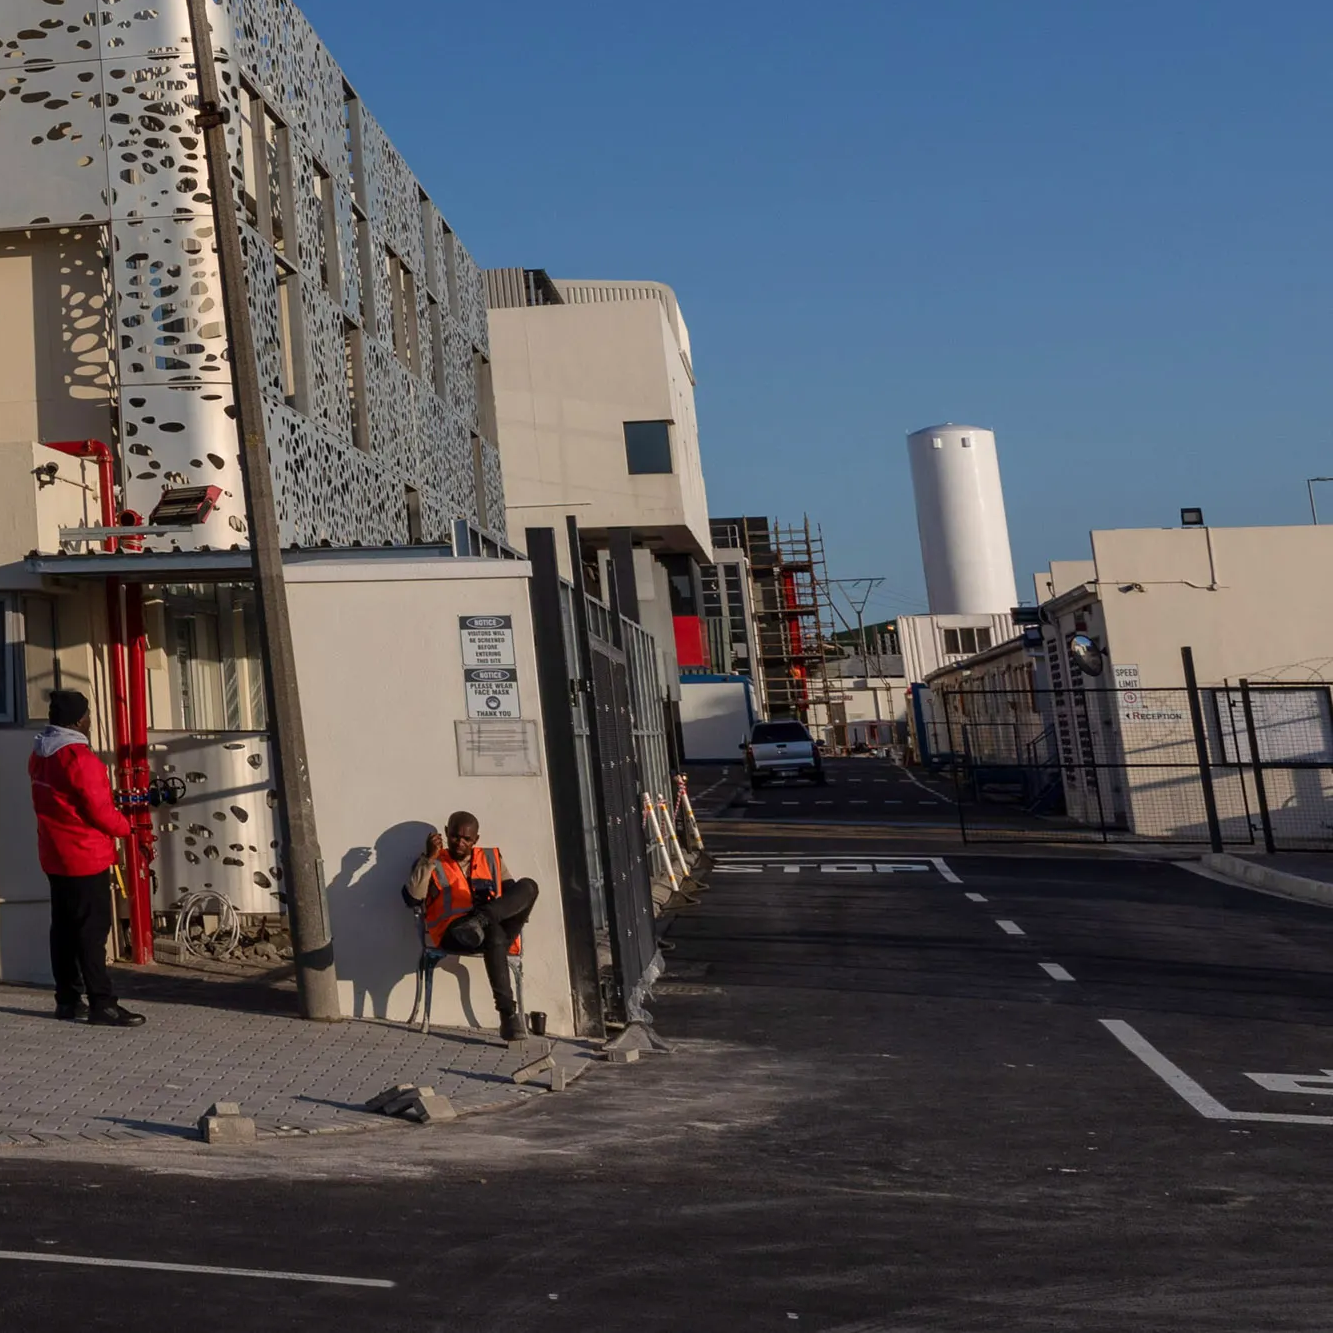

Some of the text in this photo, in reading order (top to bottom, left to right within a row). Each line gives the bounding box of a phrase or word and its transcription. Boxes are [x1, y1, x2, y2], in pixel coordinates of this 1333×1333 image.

[1115, 668, 1138, 677] SPEED
[1133, 712, 1182, 720] RECEPTION
[712, 863, 929, 873] STOP
